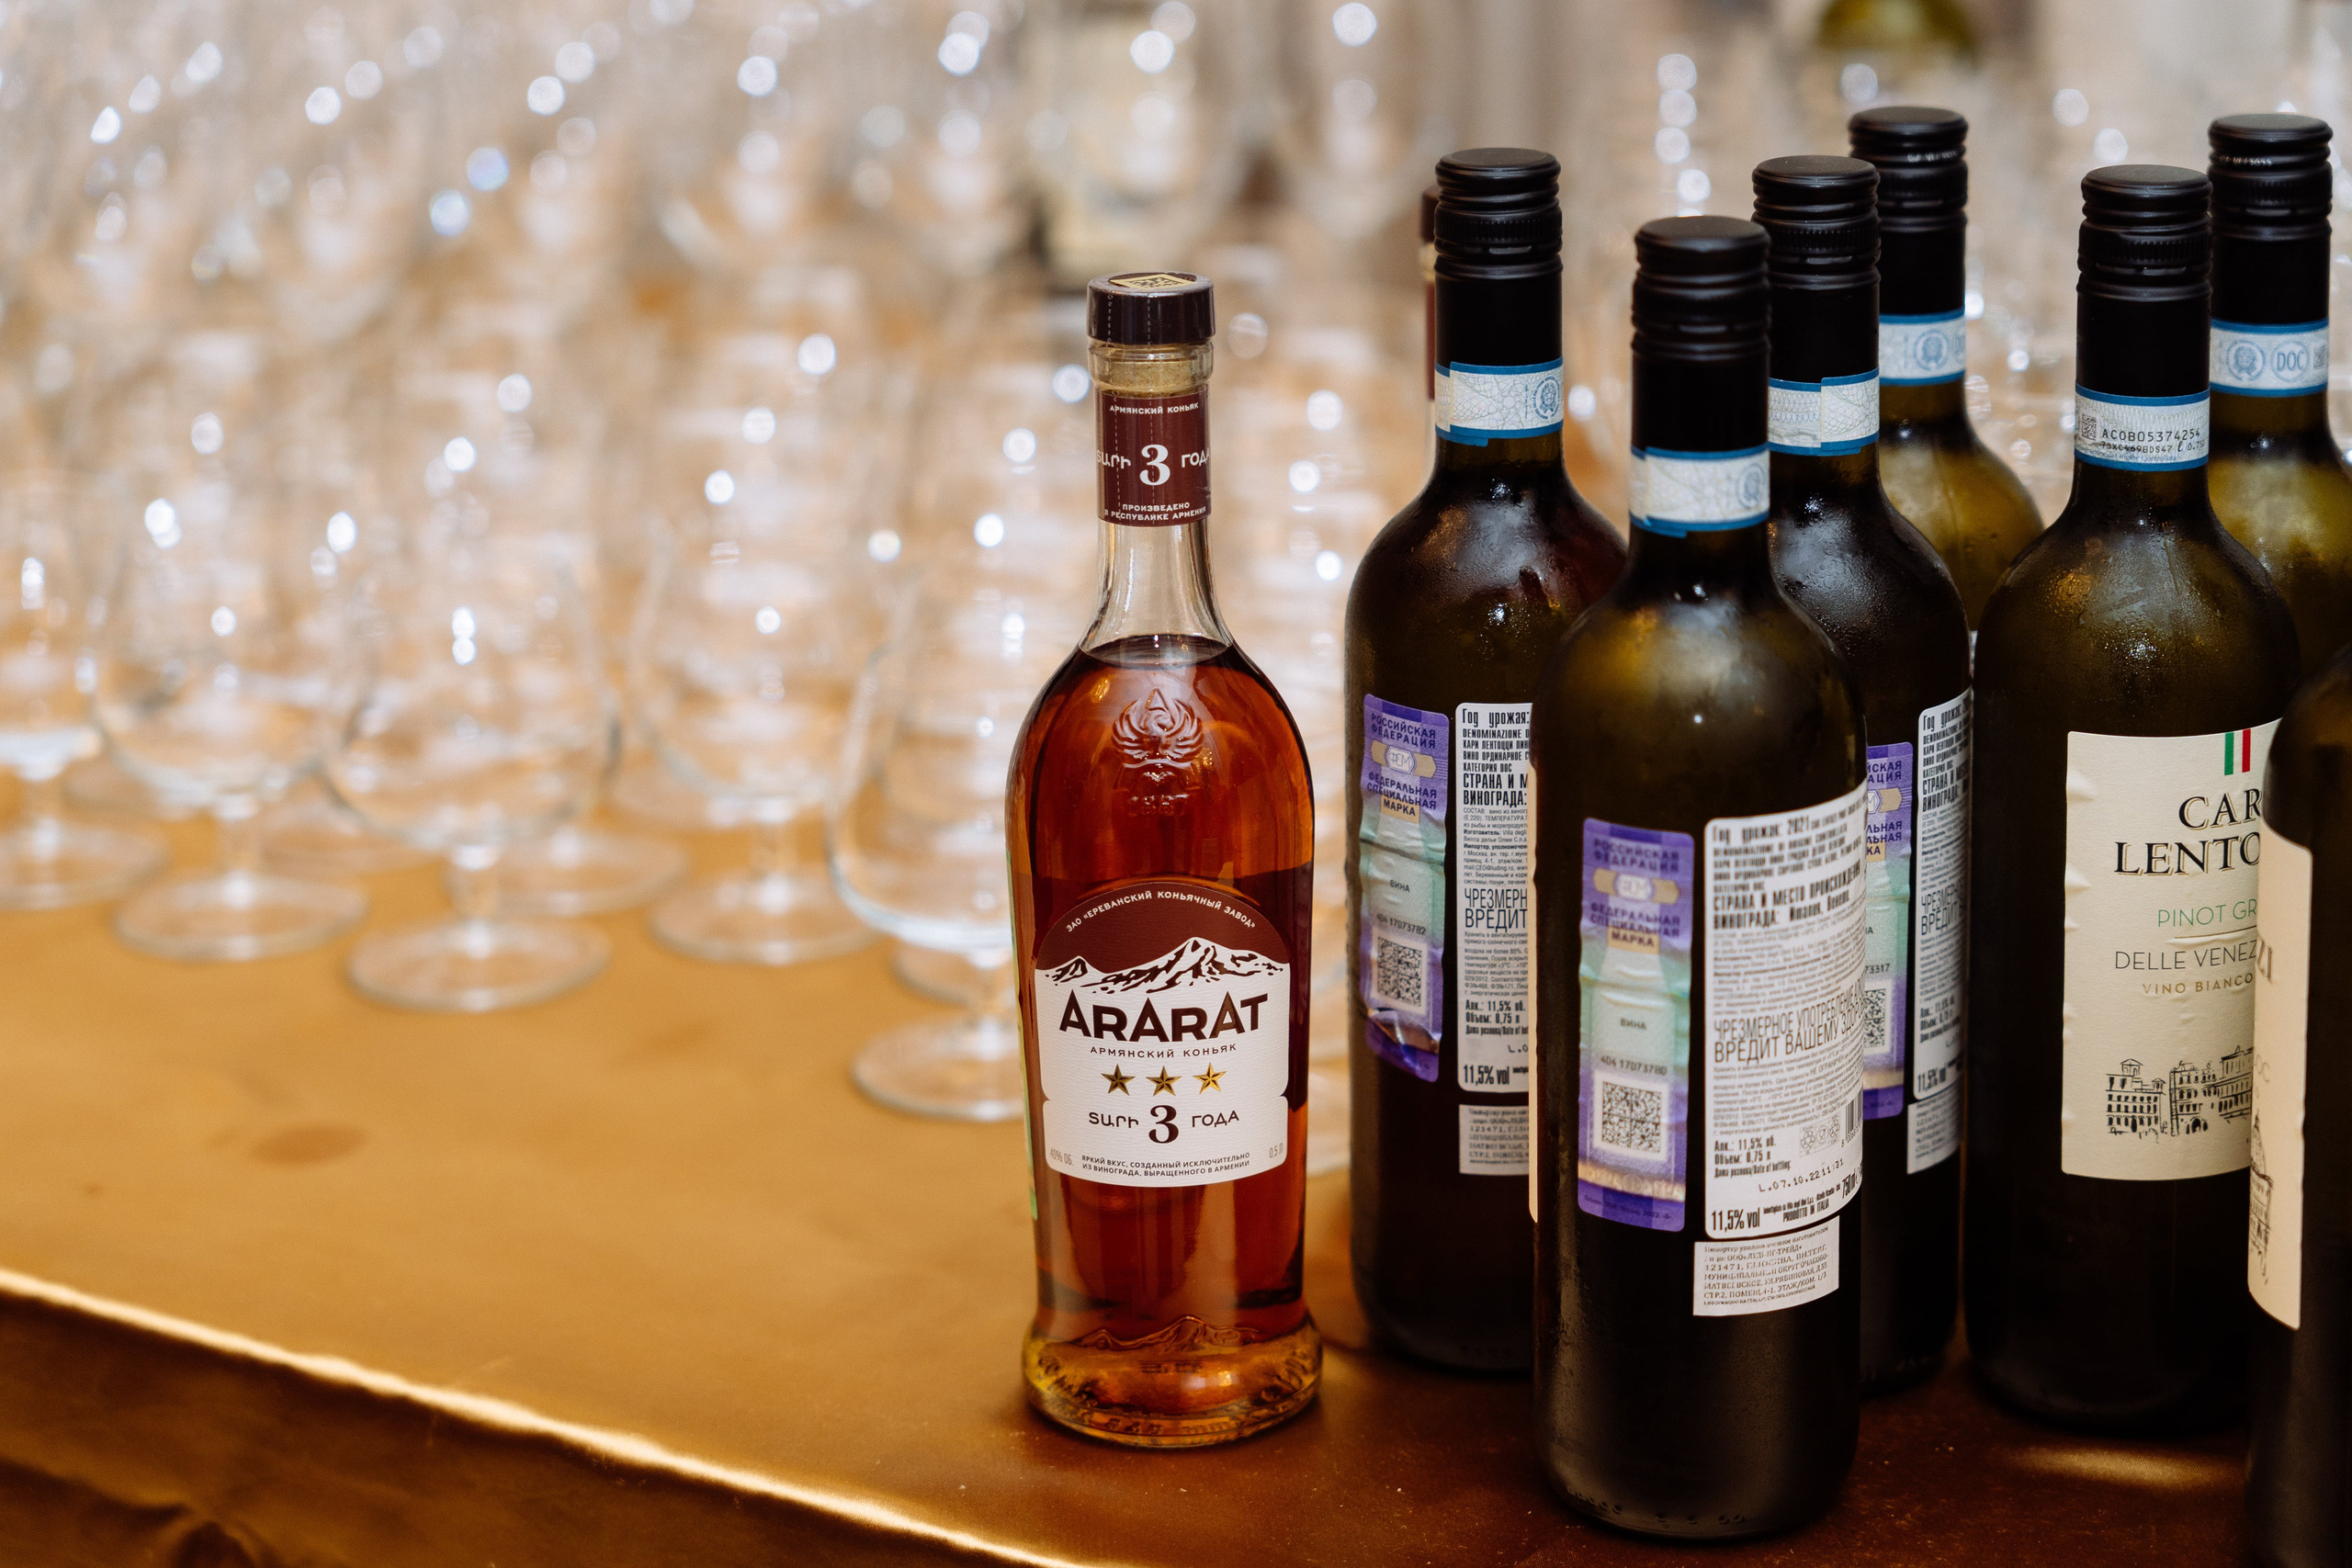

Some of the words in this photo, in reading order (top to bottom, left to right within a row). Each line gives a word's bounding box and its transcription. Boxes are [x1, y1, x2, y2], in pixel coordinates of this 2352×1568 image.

[2277, 351, 2305, 372] DOC
[1110, 404, 1163, 414] АРМЯНСКИЙ
[1168, 402, 1198, 412] КОНЬЯК
[1139, 445, 1170, 485] 3
[1182, 448, 1210, 468] ГОДА
[1112, 511, 1169, 520] РЕСПУБЛИКЕ
[1172, 507, 1205, 520] АРМЕНИЯ
[1123, 502, 1190, 511] ПРОИЗВЕДЕНО
[1372, 713, 1435, 739] РОССИЙСКАЯ
[1463, 708, 1478, 728] Год
[1489, 712, 1529, 728] урожая:
[1923, 716, 1935, 732] Год
[1372, 724, 1435, 749] ФЕДЕРАЦИЯ
[1463, 728, 1521, 739] DENOMINAZIONE
[1464, 739, 1478, 749] КАРИ
[1482, 740, 1513, 750] ЛЕНТОЦЦИ
[1464, 750, 1478, 760] ВИНО
[1482, 751, 1521, 761] ОРДИНАРНОЕ
[1464, 762, 1497, 772] КАТЕГОРИЯ
[1369, 773, 1436, 798] ФЕДЕРАЛЬНАЯ
[1464, 773, 1502, 789] СТРАНА
[1509, 773, 1514, 788] И
[1868, 772, 1901, 784] АЦИЯ
[1923, 773, 1947, 795] СТРАНА
[1367, 783, 1436, 809] СПЕЦИАЛЬНАЯ
[1464, 790, 1527, 807] ВИНОГРАДА:
[1384, 799, 1415, 816] МАРКА
[2178, 788, 2263, 830] CAR
[2114, 831, 2260, 876] LENTO
[1390, 880, 1410, 893] ВИНА
[1464, 888, 1527, 908] ЧРЕЗМЕРН
[1713, 894, 1755, 911] СТРАНА
[1773, 886, 1805, 907] МЕСТО
[1067, 918, 1081, 931] ЗАО
[1084, 891, 1152, 919] «ЕРЕВАНСКИЙ
[1158, 891, 1221, 909] КОНЬЯЧНЫЙ
[1224, 907, 1255, 928] ЗАВОД»
[1465, 908, 1528, 932] ВРЕДИТ
[2158, 904, 2226, 927] PINOT
[1611, 931, 1654, 947] МАРКА
[2115, 951, 2187, 970] DELLE
[2143, 983, 2187, 995] VINO
[2195, 972, 2254, 993] BIANCO
[1059, 989, 1268, 1043] ARARAT
[1466, 1011, 1492, 1023] Объем:
[1620, 1018, 1646, 1030] ВИНА
[1713, 1011, 1793, 1041] ЧРЕЗМЕРНОЕ
[1091, 1047, 1174, 1058] АРМЯНСКИЙ
[1183, 1043, 1237, 1057] КОНЬЯК
[1714, 1035, 1781, 1065] ВРЕДИТ
[1786, 1018, 1838, 1055] ВАШЕМУ
[1464, 1065, 1494, 1086] 11,5%
[1497, 1066, 1510, 1085] vol
[1148, 1105, 1179, 1144] 3
[1192, 1111, 1239, 1127] ГОДА
[1082, 1155, 1105, 1165] ЯРКИЙ
[1107, 1158, 1128, 1168] ВКУС,
[1131, 1160, 1181, 1168] СОЗДАННЫЙ
[1183, 1153, 1250, 1167] ИСКЛЮЧИТЕЛЬНО
[1094, 1165, 1142, 1177] ВИНОГРАДА,
[1145, 1168, 1205, 1177] ВЫРАЩЕННОГО
[1215, 1161, 1250, 1173] АРМЕНИИ
[1714, 1154, 1742, 1165] Объем:
[1712, 1209, 1745, 1233] 11,5%
[1747, 1207, 1760, 1228] vol
[1779, 1265, 1799, 1274] ОКРУГ
